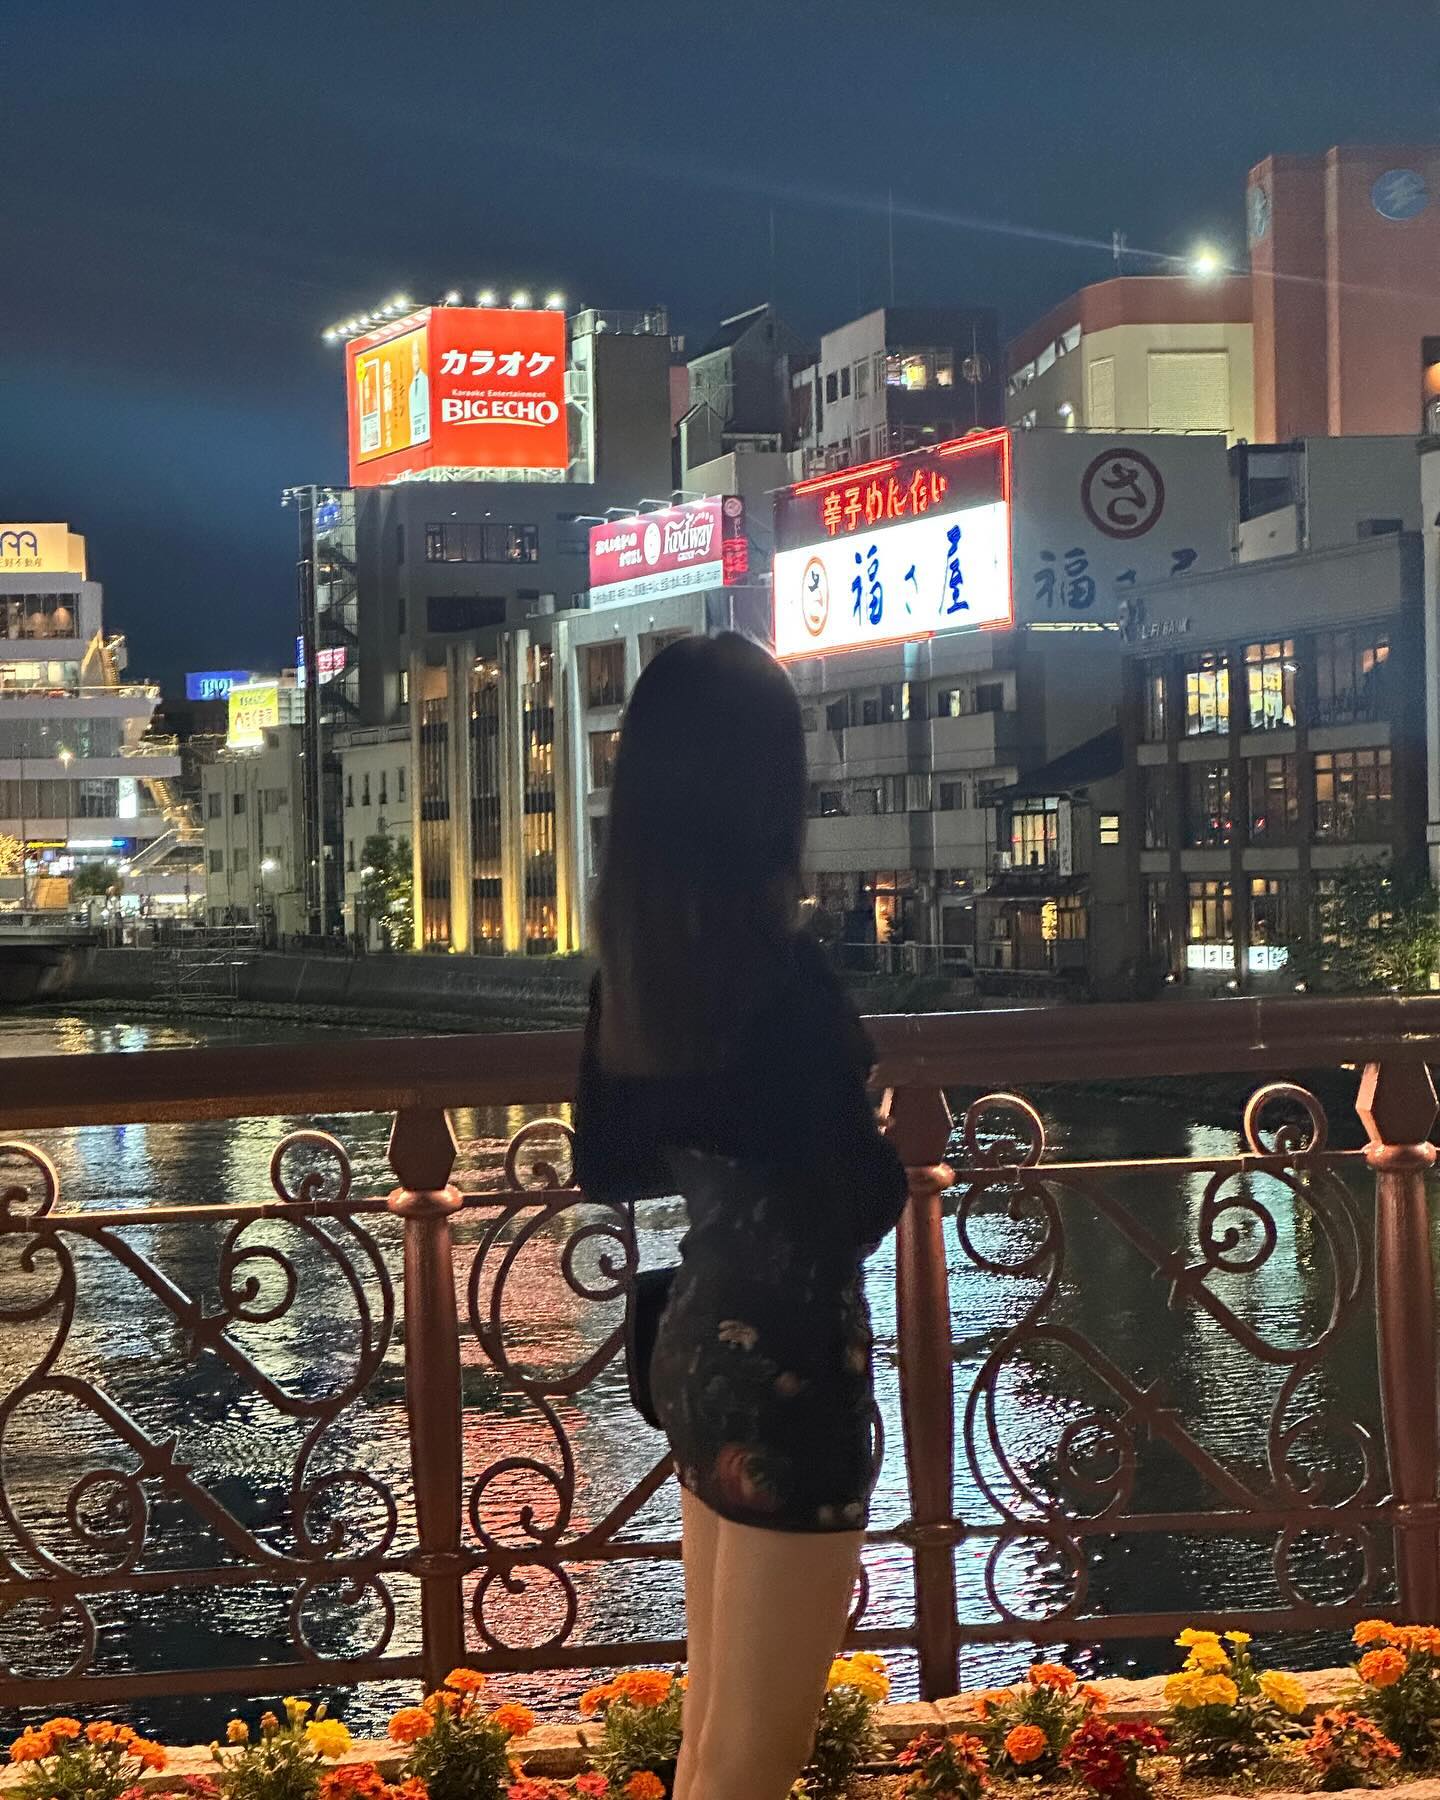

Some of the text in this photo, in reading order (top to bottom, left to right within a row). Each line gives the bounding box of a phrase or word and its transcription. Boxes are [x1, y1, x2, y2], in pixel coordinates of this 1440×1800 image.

[440, 349, 556, 377] カラオケ
[451, 388, 547, 398] Karaoke Entertainment
[441, 398, 559, 424] BIG ECHO
[662, 512, 715, 556] Foodway
